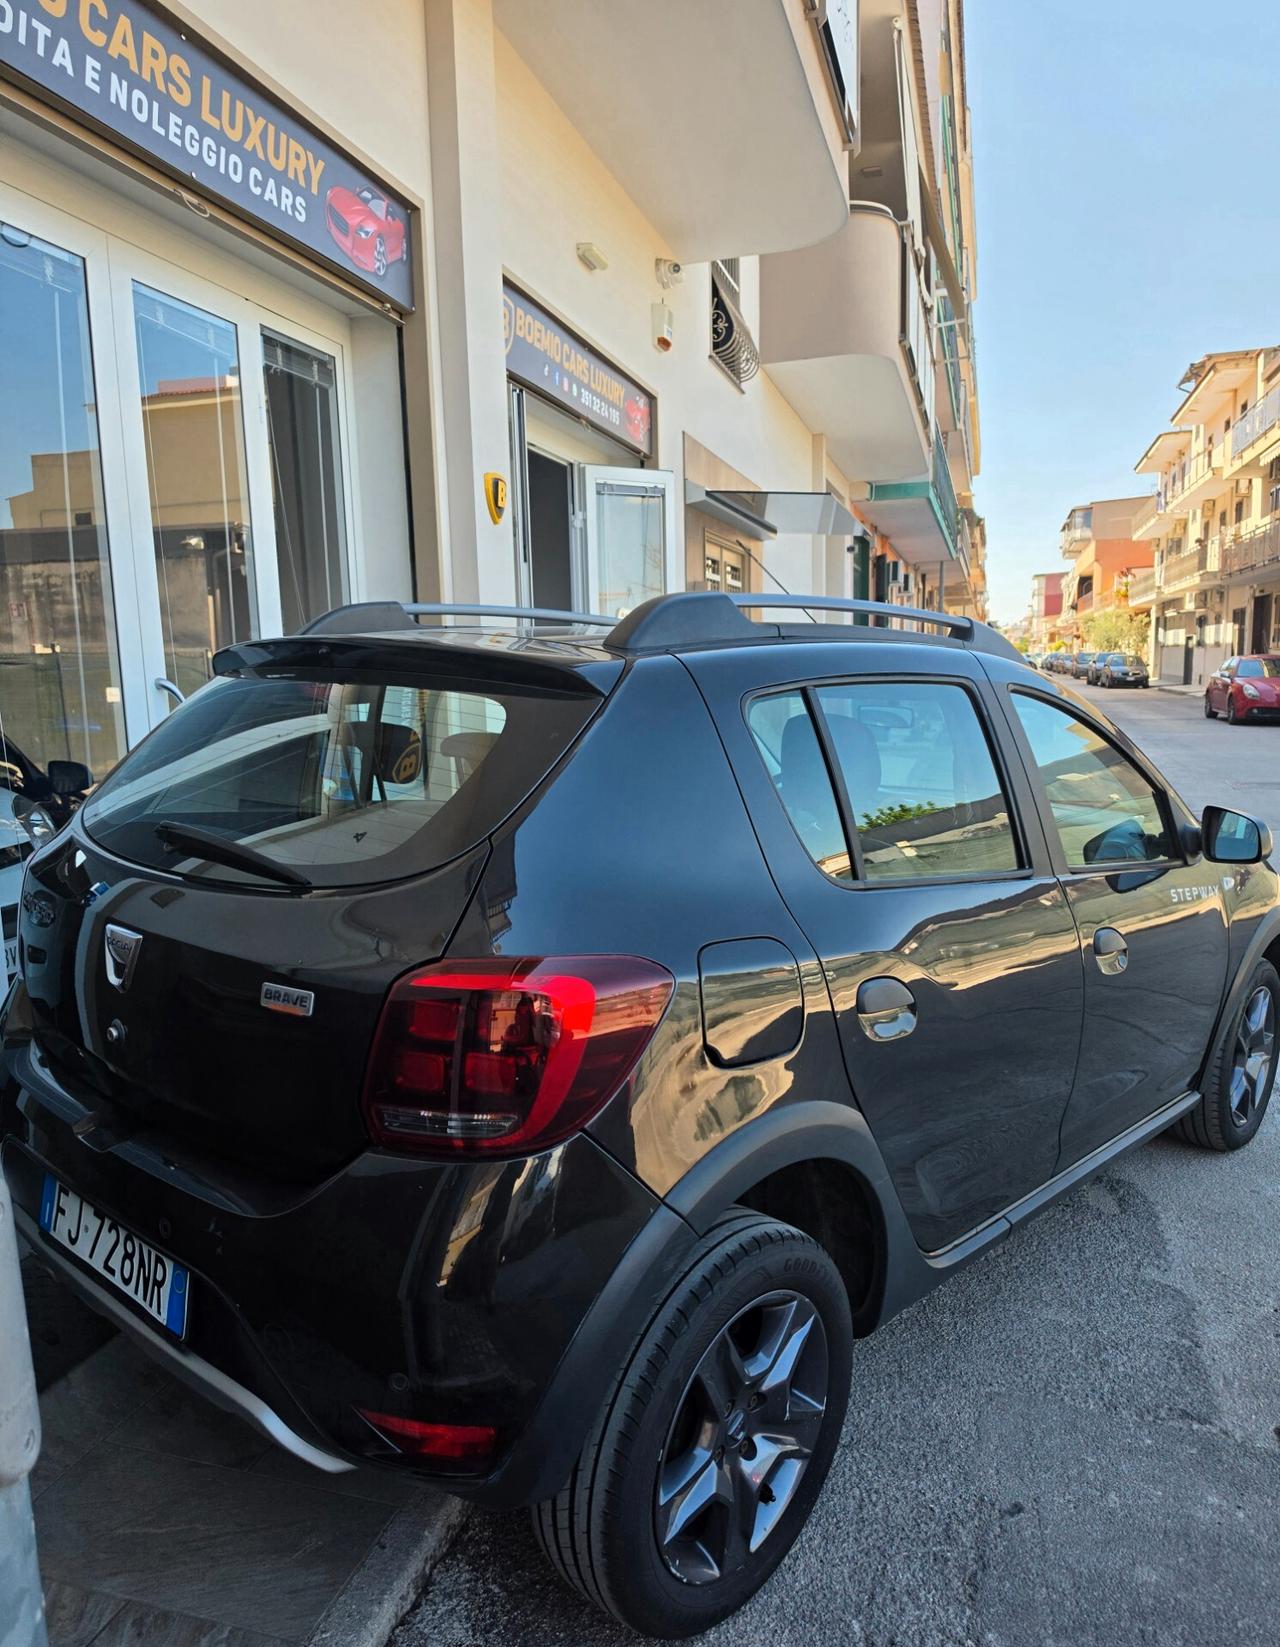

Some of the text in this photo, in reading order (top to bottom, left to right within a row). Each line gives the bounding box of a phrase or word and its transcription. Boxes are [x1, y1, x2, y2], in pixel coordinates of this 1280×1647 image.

[79, 0, 326, 196] CARS LUXURY
[85, 54, 101, 95] E
[110, 72, 243, 184] NOLEGGIO
[249, 167, 307, 223] CARS
[515, 307, 562, 364] BOEMIO
[562, 343, 590, 385] CARS
[590, 365, 625, 409] LUXURY
[1170, 884, 1220, 903] STEPWAY
[264, 987, 309, 1009] BRAVE
